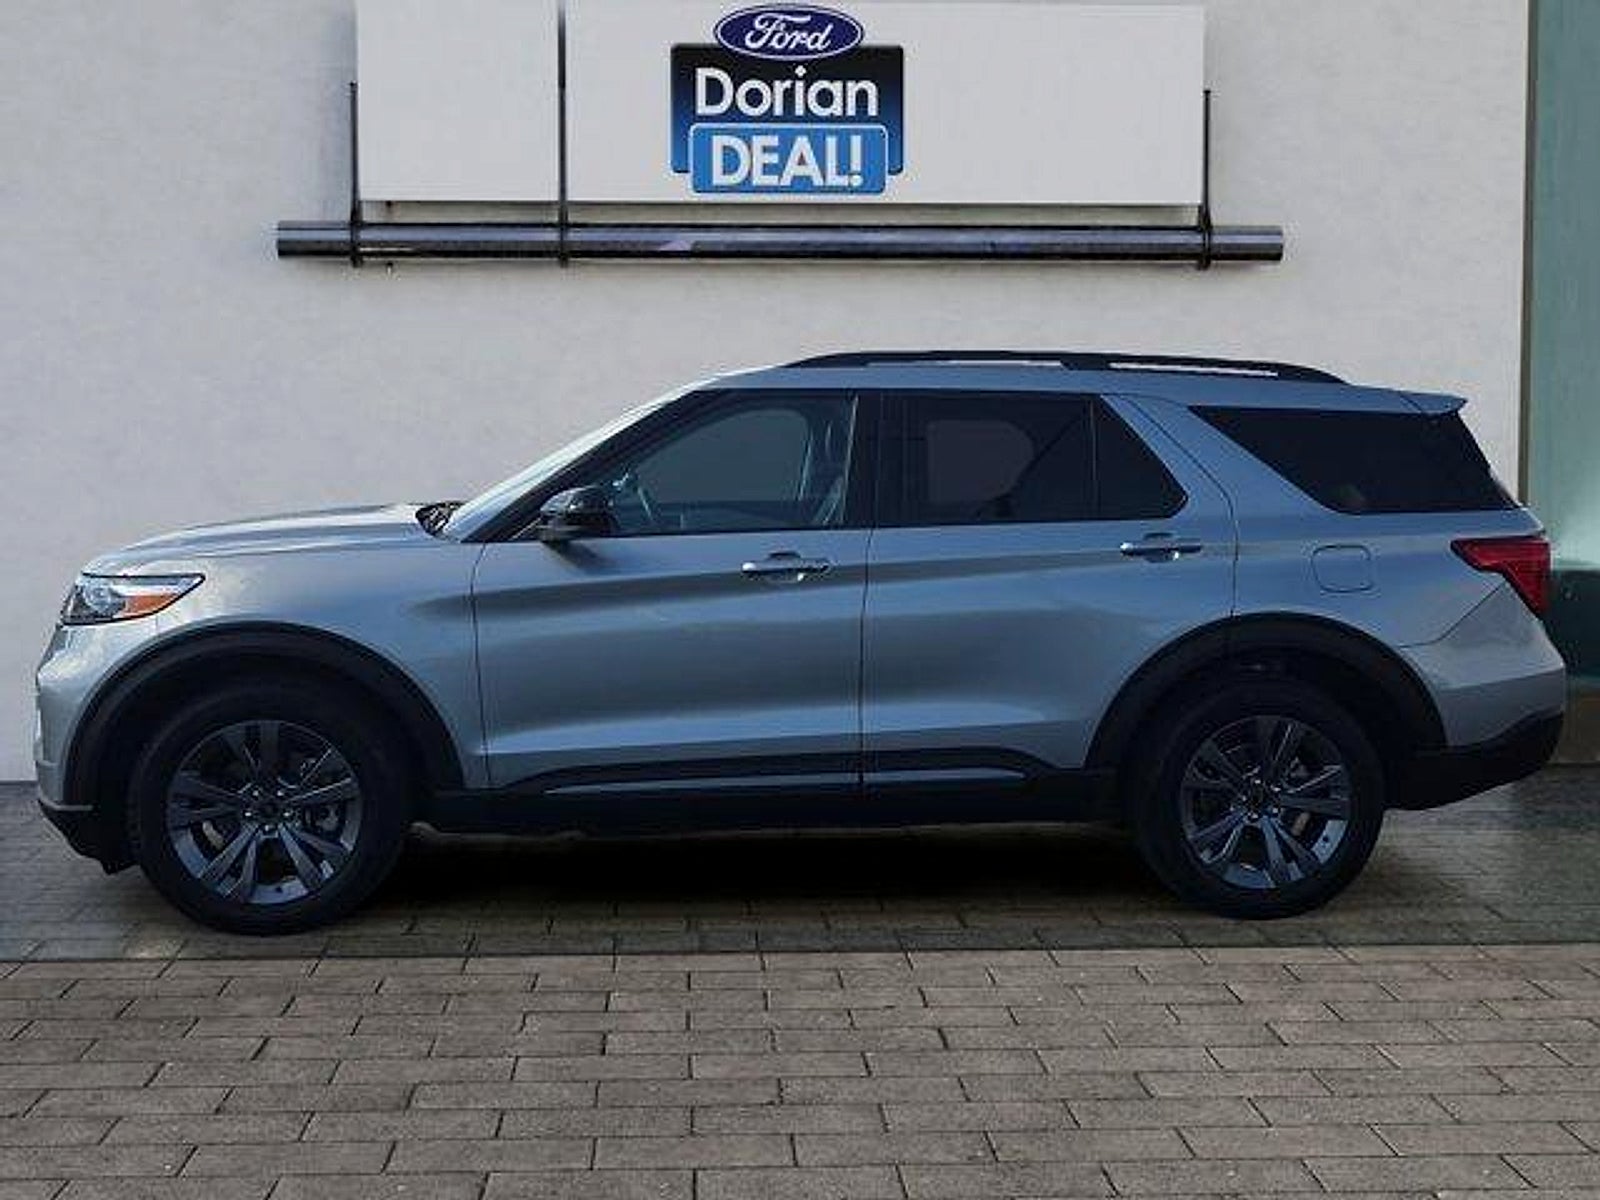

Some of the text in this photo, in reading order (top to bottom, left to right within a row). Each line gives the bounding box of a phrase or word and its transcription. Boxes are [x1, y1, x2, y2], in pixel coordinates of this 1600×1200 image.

[744, 12, 834, 50] Ford
[695, 65, 878, 117] Dorian
[711, 134, 863, 187] DEAL!
